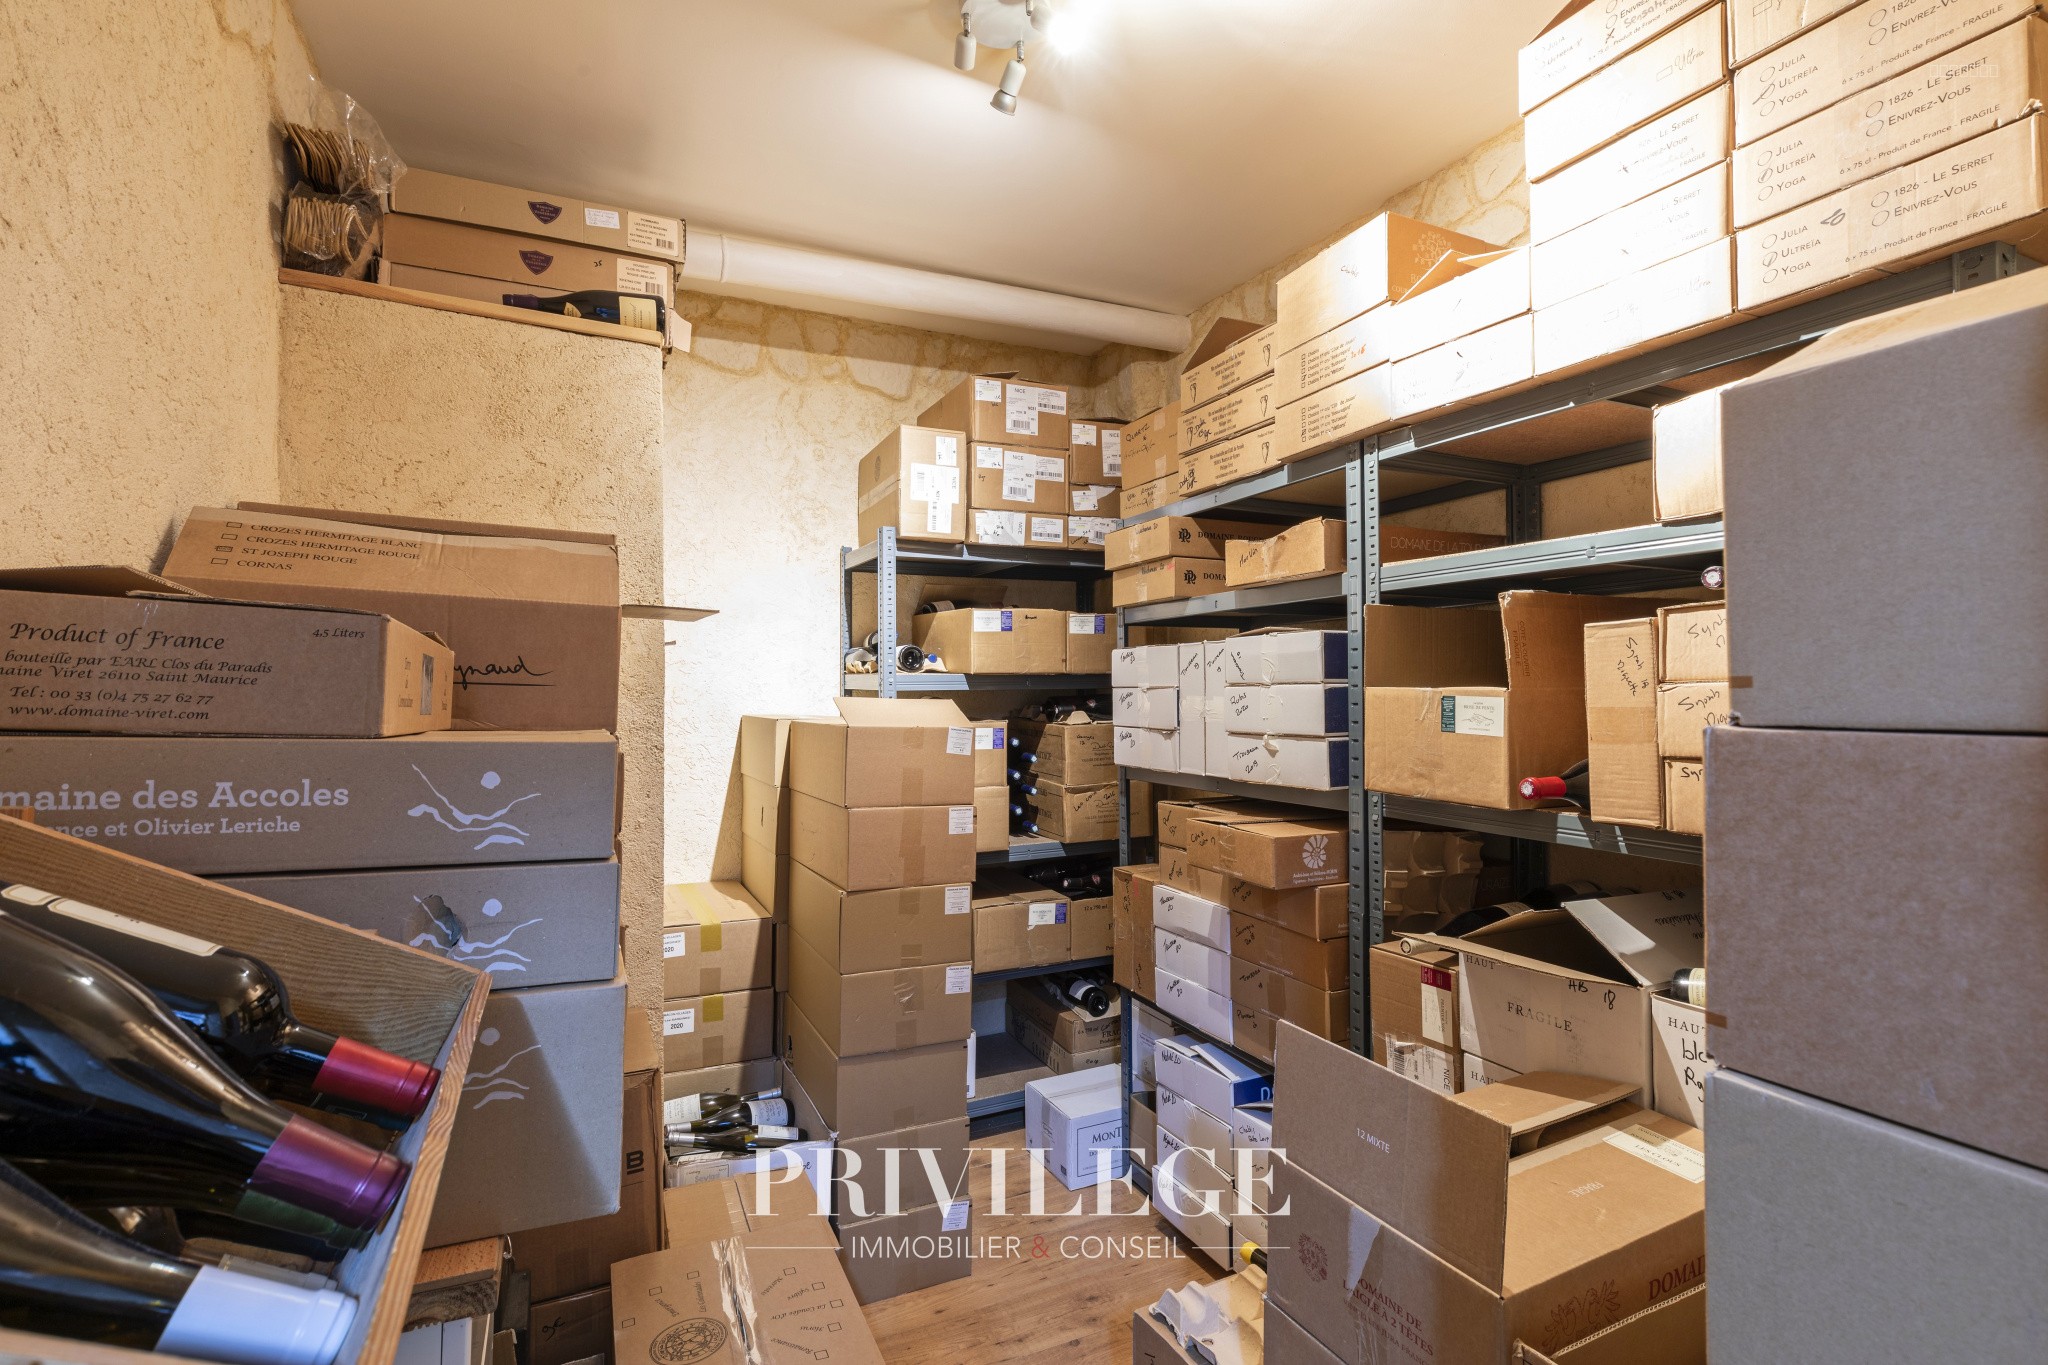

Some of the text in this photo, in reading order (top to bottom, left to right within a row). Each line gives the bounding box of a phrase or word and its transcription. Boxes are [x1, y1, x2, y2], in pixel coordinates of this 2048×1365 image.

[1841, 78, 1848, 86] 6
[1854, 70, 1865, 80] 75
[1866, 66, 1875, 76] cl
[1881, 49, 1911, 68] Produit
[1912, 43, 1924, 53] de
[1925, 28, 1955, 47] France
[1962, 4, 2004, 30] FRAGILE
[1778, 53, 1806, 72] JULIA
[1779, 64, 1819, 89] ULTREÏA
[1888, 88, 1915, 107] 1826
[1927, 77, 1942, 90] LE
[1945, 57, 1989, 81] SERRET
[1779, 88, 1809, 106] YOGA
[1888, 84, 1972, 127] ENIVREZ-VOUS
[1671, 113, 1699, 133] SERRET
[1776, 139, 1804, 158] JULIA
[1839, 167, 1846, 175] 6
[1853, 161, 1863, 170] 75
[1864, 157, 1872, 166] cl
[1878, 142, 1908, 160] Produit
[1910, 137, 1921, 147] de
[1923, 122, 1953, 142] France
[1960, 103, 2001, 126] FRAGILE
[1679, 151, 1706, 168] FRAGILE
[1776, 152, 1817, 175] ULTREÏA
[1777, 175, 1807, 193] YOGA
[1894, 153, 1996, 198] 1826 LE SERRET
[1894, 180, 1979, 218] ENIVREZ-VOUS
[1780, 224, 1809, 242] JULIA
[1845, 255, 1851, 263] 6
[1858, 250, 1869, 259] 75
[1870, 247, 1878, 256] cl
[1884, 232, 1914, 250] Produit
[1916, 229, 1928, 239] de
[1929, 218, 1959, 235] France
[1966, 201, 2008, 223] FRAGILE
[1781, 238, 1822, 259] ULTREÏA
[1781, 260, 1812, 277] YOGA
[246, 535, 421, 560] CROZES HERMITAGE ROUGE
[250, 524, 423, 549] CROZES HERMITAGE BLANC
[1197, 531, 1235, 541] DOMAINE
[1390, 536, 1431, 550] DOMAINE
[1434, 540, 1447, 551] DE
[237, 559, 293, 571] CORNAS
[241, 546, 358, 565] ST JOSEPH ROUGE
[9, 622, 226, 651] Product of France
[332, 627, 365, 639] Liters
[1512, 629, 1522, 667] FRAGILE
[1626, 637, 1644, 670] Syrah
[4, 649, 273, 674] bouteille par EARL Clos du Paradis
[50, 665, 259, 686] Viret 26110 Saint Maurice
[50, 690, 71, 700] 00
[75, 691, 92, 702] 33
[97, 688, 128, 704] (0)4
[131, 693, 149, 704] 75
[153, 693, 171, 704] 27
[175, 693, 192, 704] 62
[196, 695, 215, 706] 77
[8, 704, 210, 721] www.domaine-viret.com
[132, 779, 199, 809] des
[208, 779, 350, 808] Accoles
[104, 814, 302, 837] et Olivier Leriche
[1465, 954, 1497, 970] HAUT
[1603, 988, 1617, 1011] 18
[670, 1021, 684, 1030] 2020
[1507, 1001, 1574, 1033] FRAGILE
[1443, 1066, 1451, 1092] NICE
[1356, 1127, 1390, 1155] 12 MIXTE
[1357, 1278, 1423, 1332] OMAINE DE
[771, 1337, 814, 1355] Renaissance
[1390, 1317, 1398, 1328] 2
[1399, 1321, 1434, 1356] TÊTES
